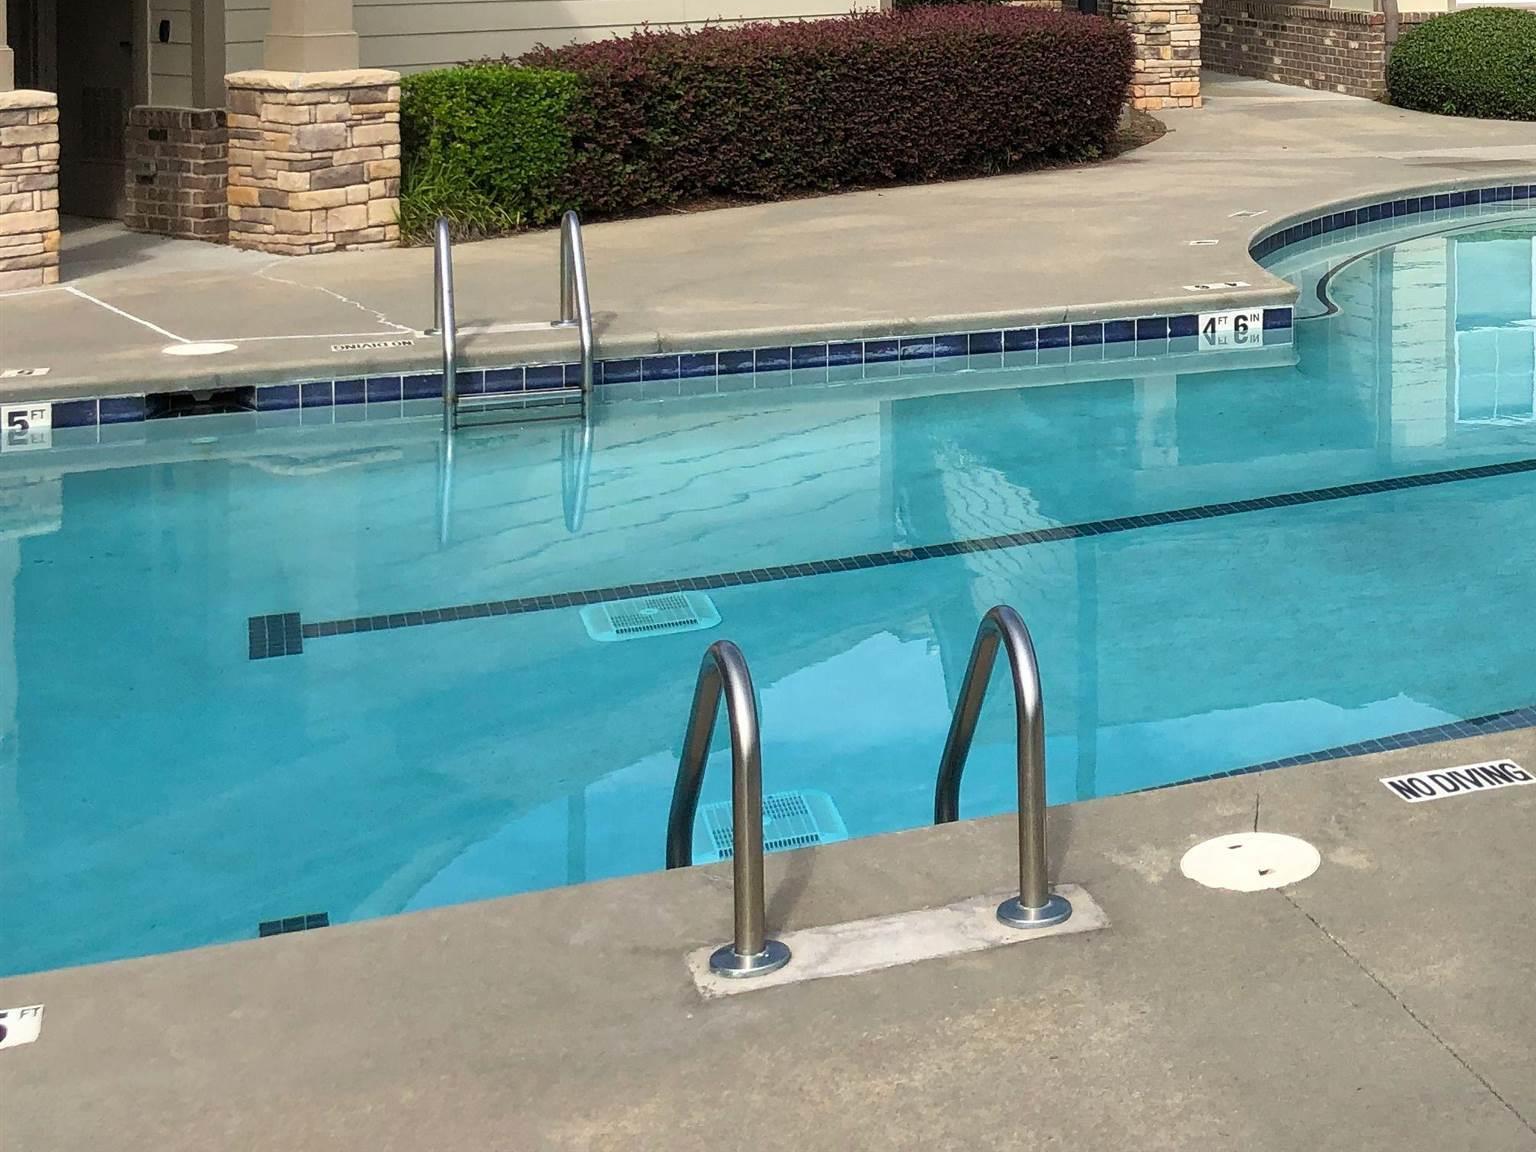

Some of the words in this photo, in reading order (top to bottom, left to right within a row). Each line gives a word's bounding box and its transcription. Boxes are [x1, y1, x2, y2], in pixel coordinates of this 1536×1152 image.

[1218, 316, 1228, 325] FT
[1234, 314, 1249, 332] 6
[1250, 313, 1260, 322] IN
[8, 410, 30, 430] 5
[31, 409, 46, 420] FT
[1388, 777, 1437, 799] NO
[1427, 762, 1534, 793] DIVING
[20, 1007, 41, 1019] FT
